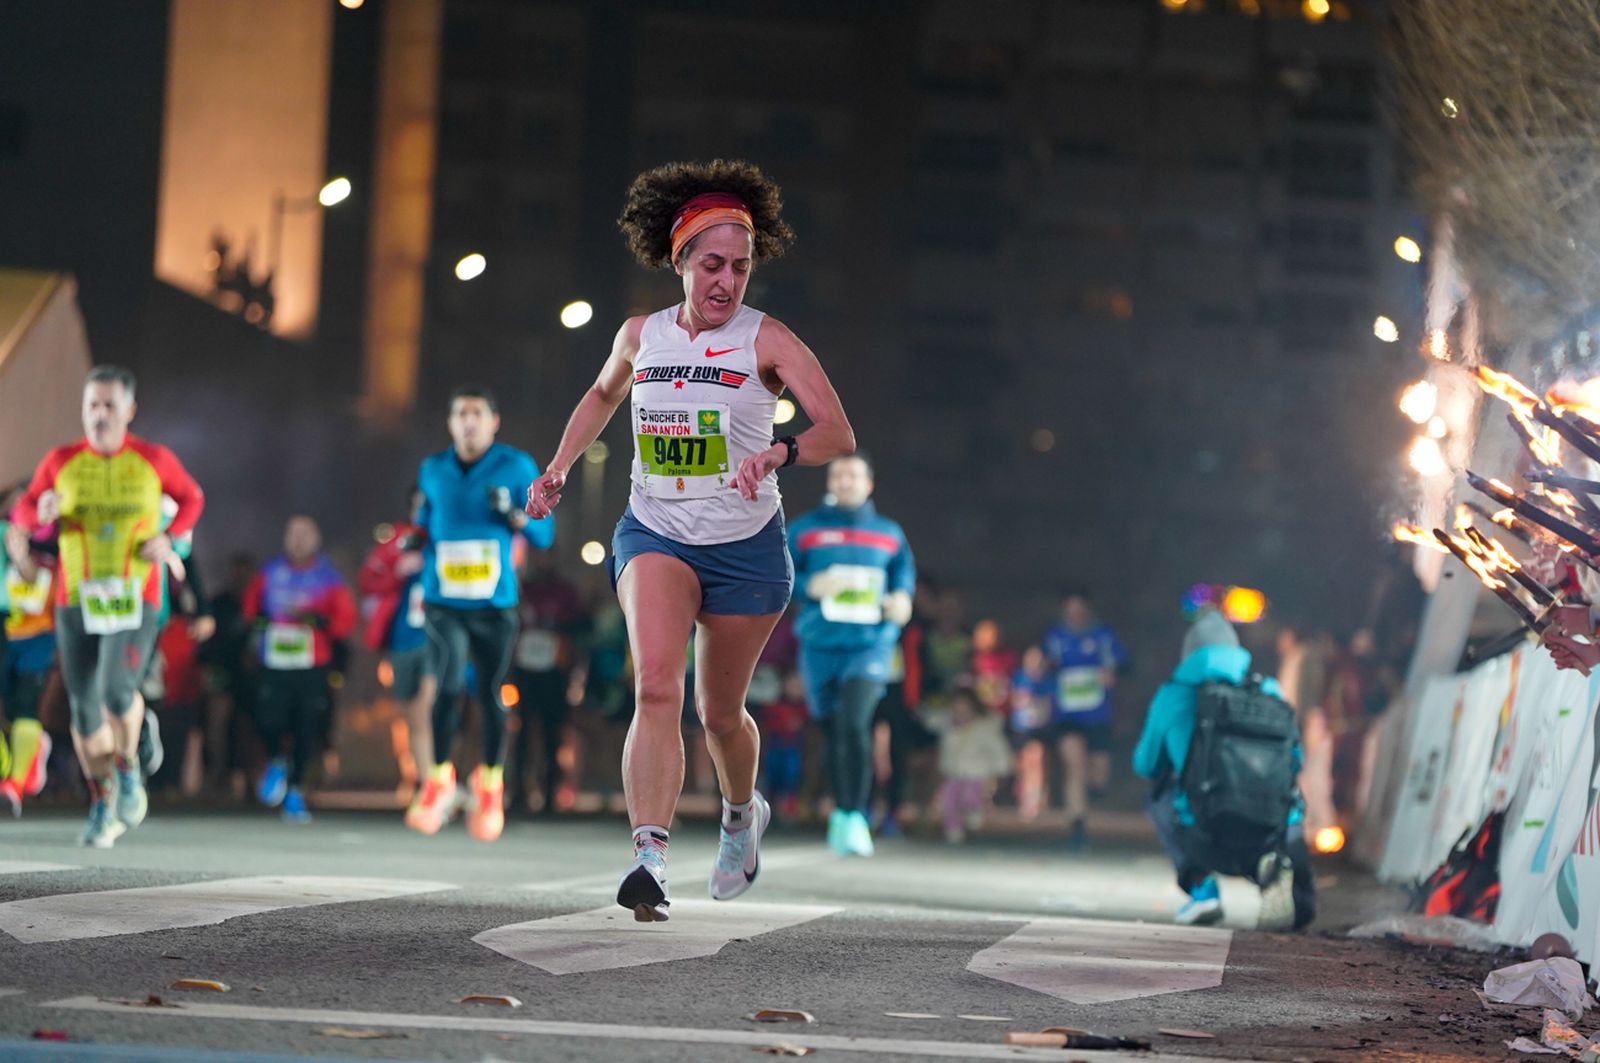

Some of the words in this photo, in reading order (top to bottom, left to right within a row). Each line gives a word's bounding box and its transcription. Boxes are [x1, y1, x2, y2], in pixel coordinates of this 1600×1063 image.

[692, 366, 721, 381] RUN
[648, 413, 676, 423] NOCHE
[678, 413, 689, 423] DE
[641, 424, 658, 434] SAN
[659, 422, 691, 436] ANTÓN
[654, 436, 707, 466] 9477
